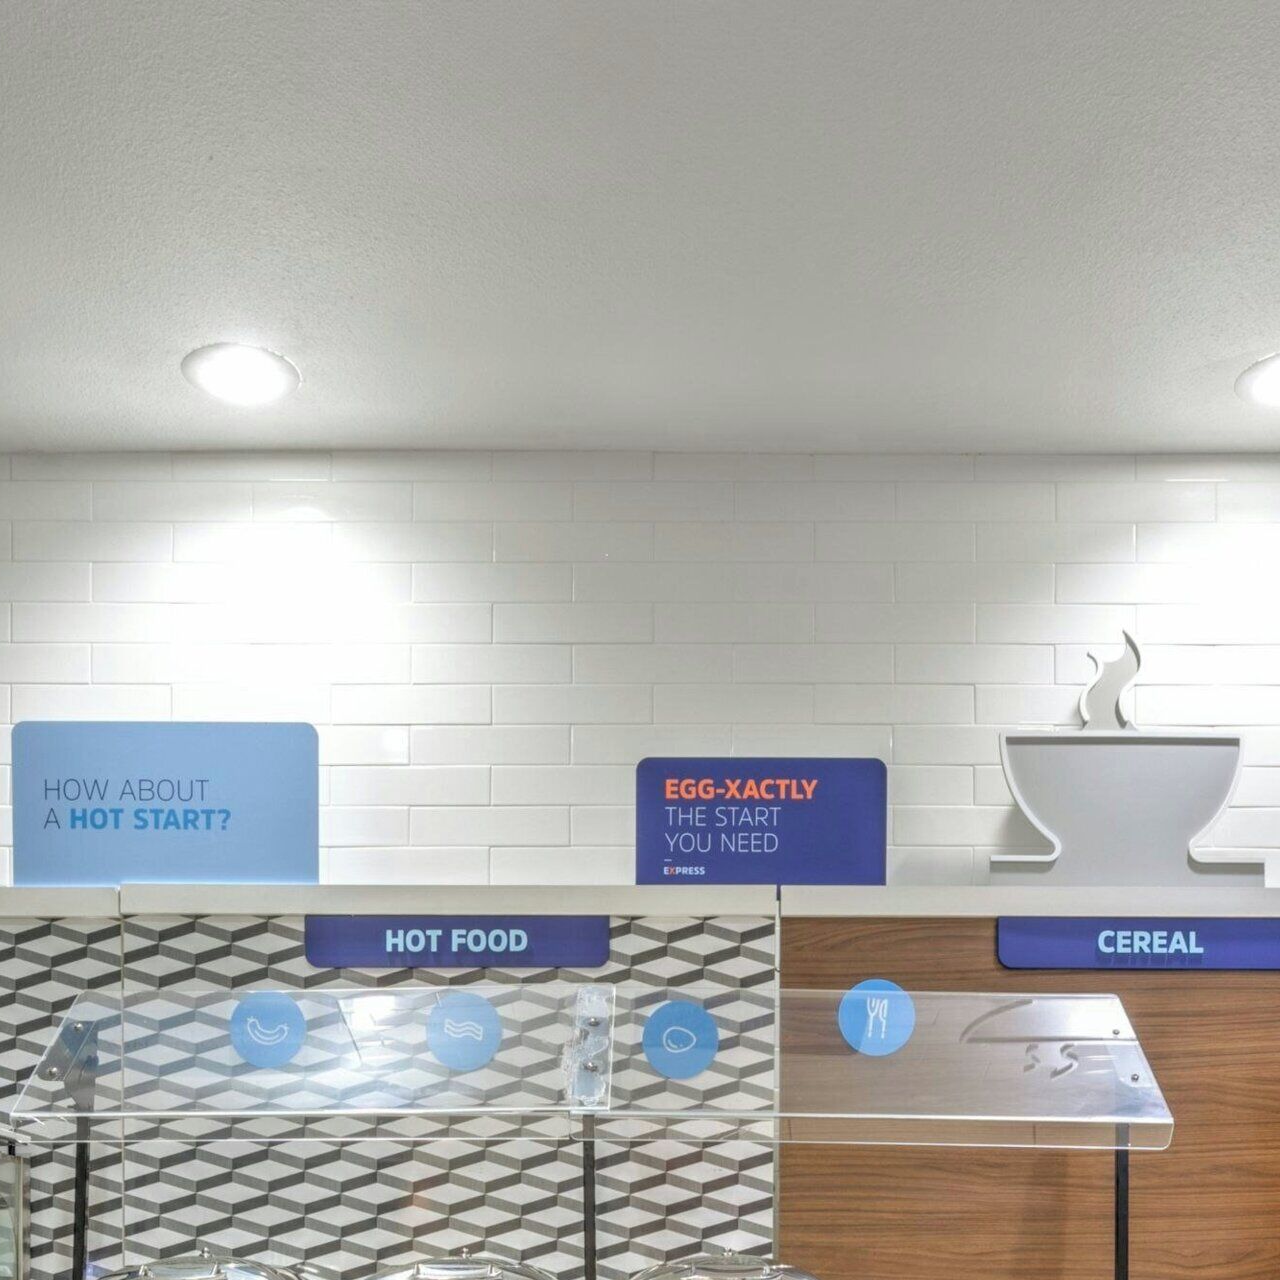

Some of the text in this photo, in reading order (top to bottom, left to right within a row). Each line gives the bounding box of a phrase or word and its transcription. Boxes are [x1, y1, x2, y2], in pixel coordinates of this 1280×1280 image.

[43, 778, 210, 802] HOW ABOUT
[664, 779, 819, 800] EGG-XACTLY
[43, 807, 232, 830] A HOT START?
[664, 806, 782, 827] THE START
[664, 832, 779, 853] YOU NEED
[663, 866, 706, 876] EXPRESS
[385, 929, 528, 953] HOT FOOD
[1097, 930, 1205, 954] CEREAL
